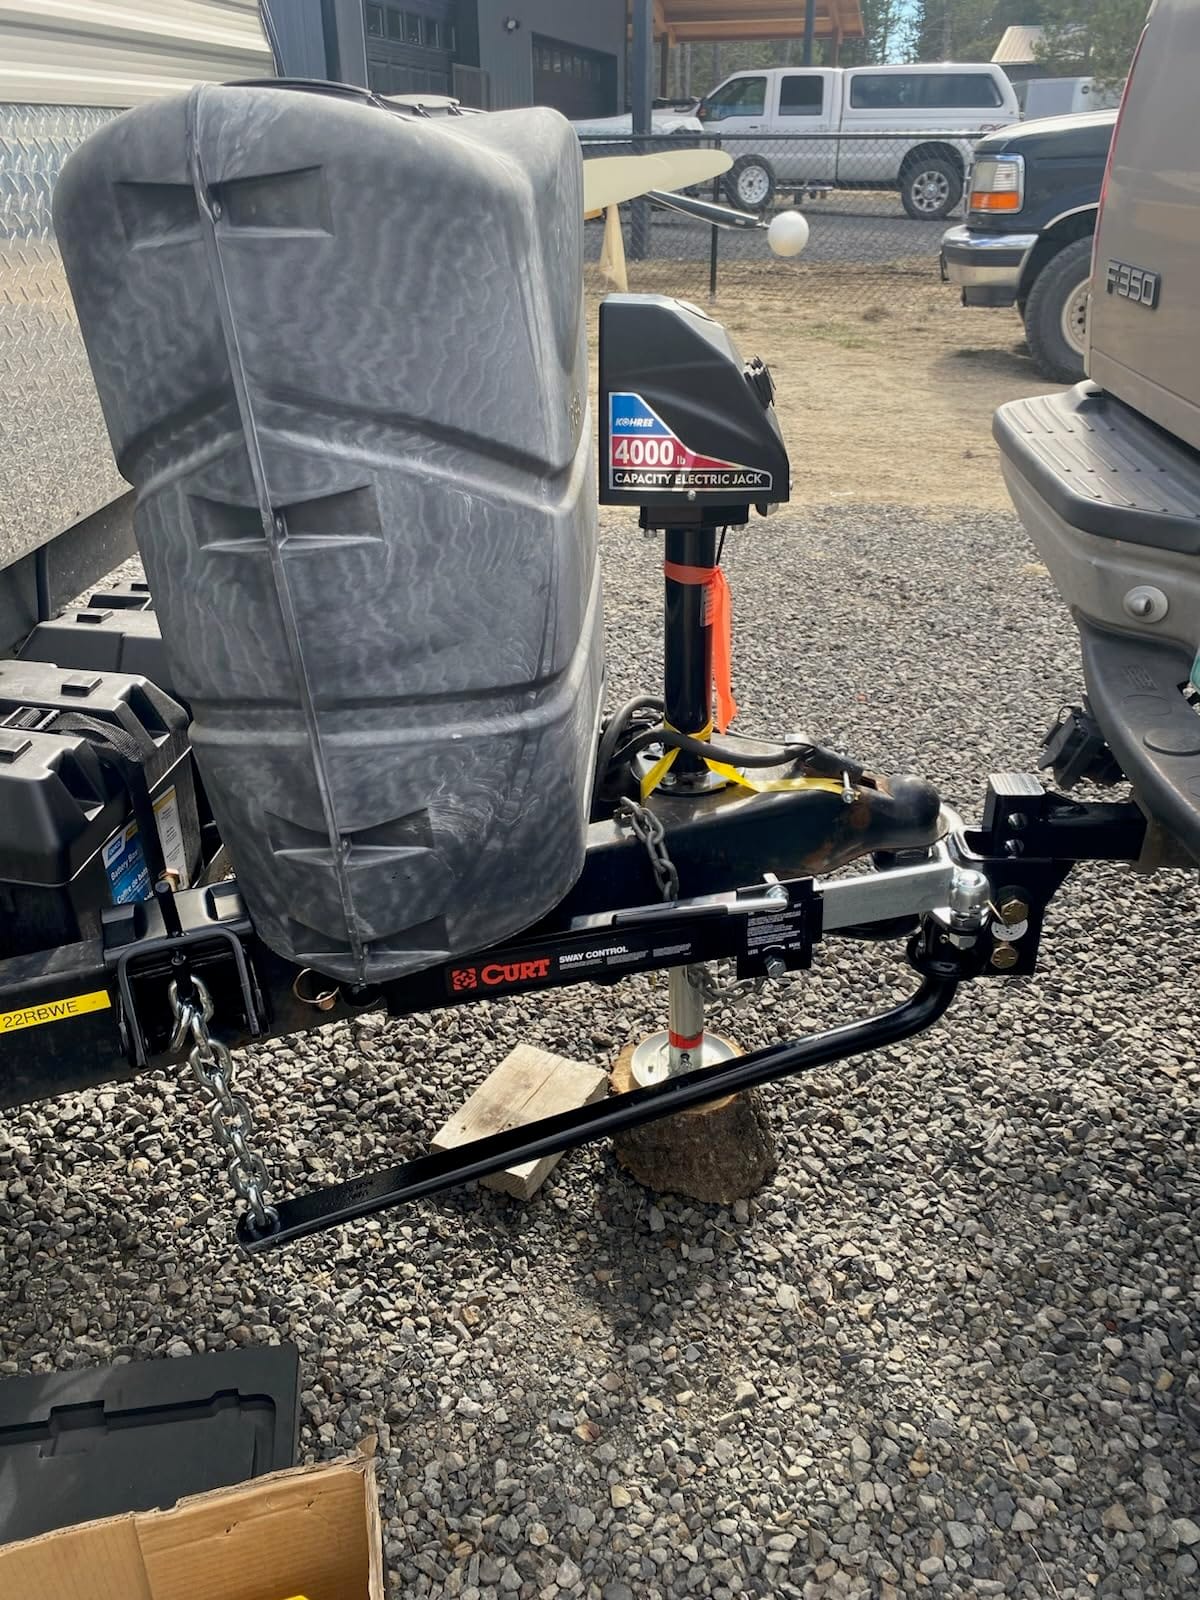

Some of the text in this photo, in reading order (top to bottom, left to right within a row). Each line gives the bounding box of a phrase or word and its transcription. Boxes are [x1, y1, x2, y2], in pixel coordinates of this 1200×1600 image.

[615, 417, 654, 428] KOHREE
[615, 439, 686, 465] 4000 lb
[615, 473, 762, 485] CAPACITY ELECTRIC JACK
[559, 952, 584, 964] SWAY
[585, 945, 629, 960] CONTROL
[481, 958, 551, 985] CURT
[3, 1001, 79, 1028] 22RBWE
